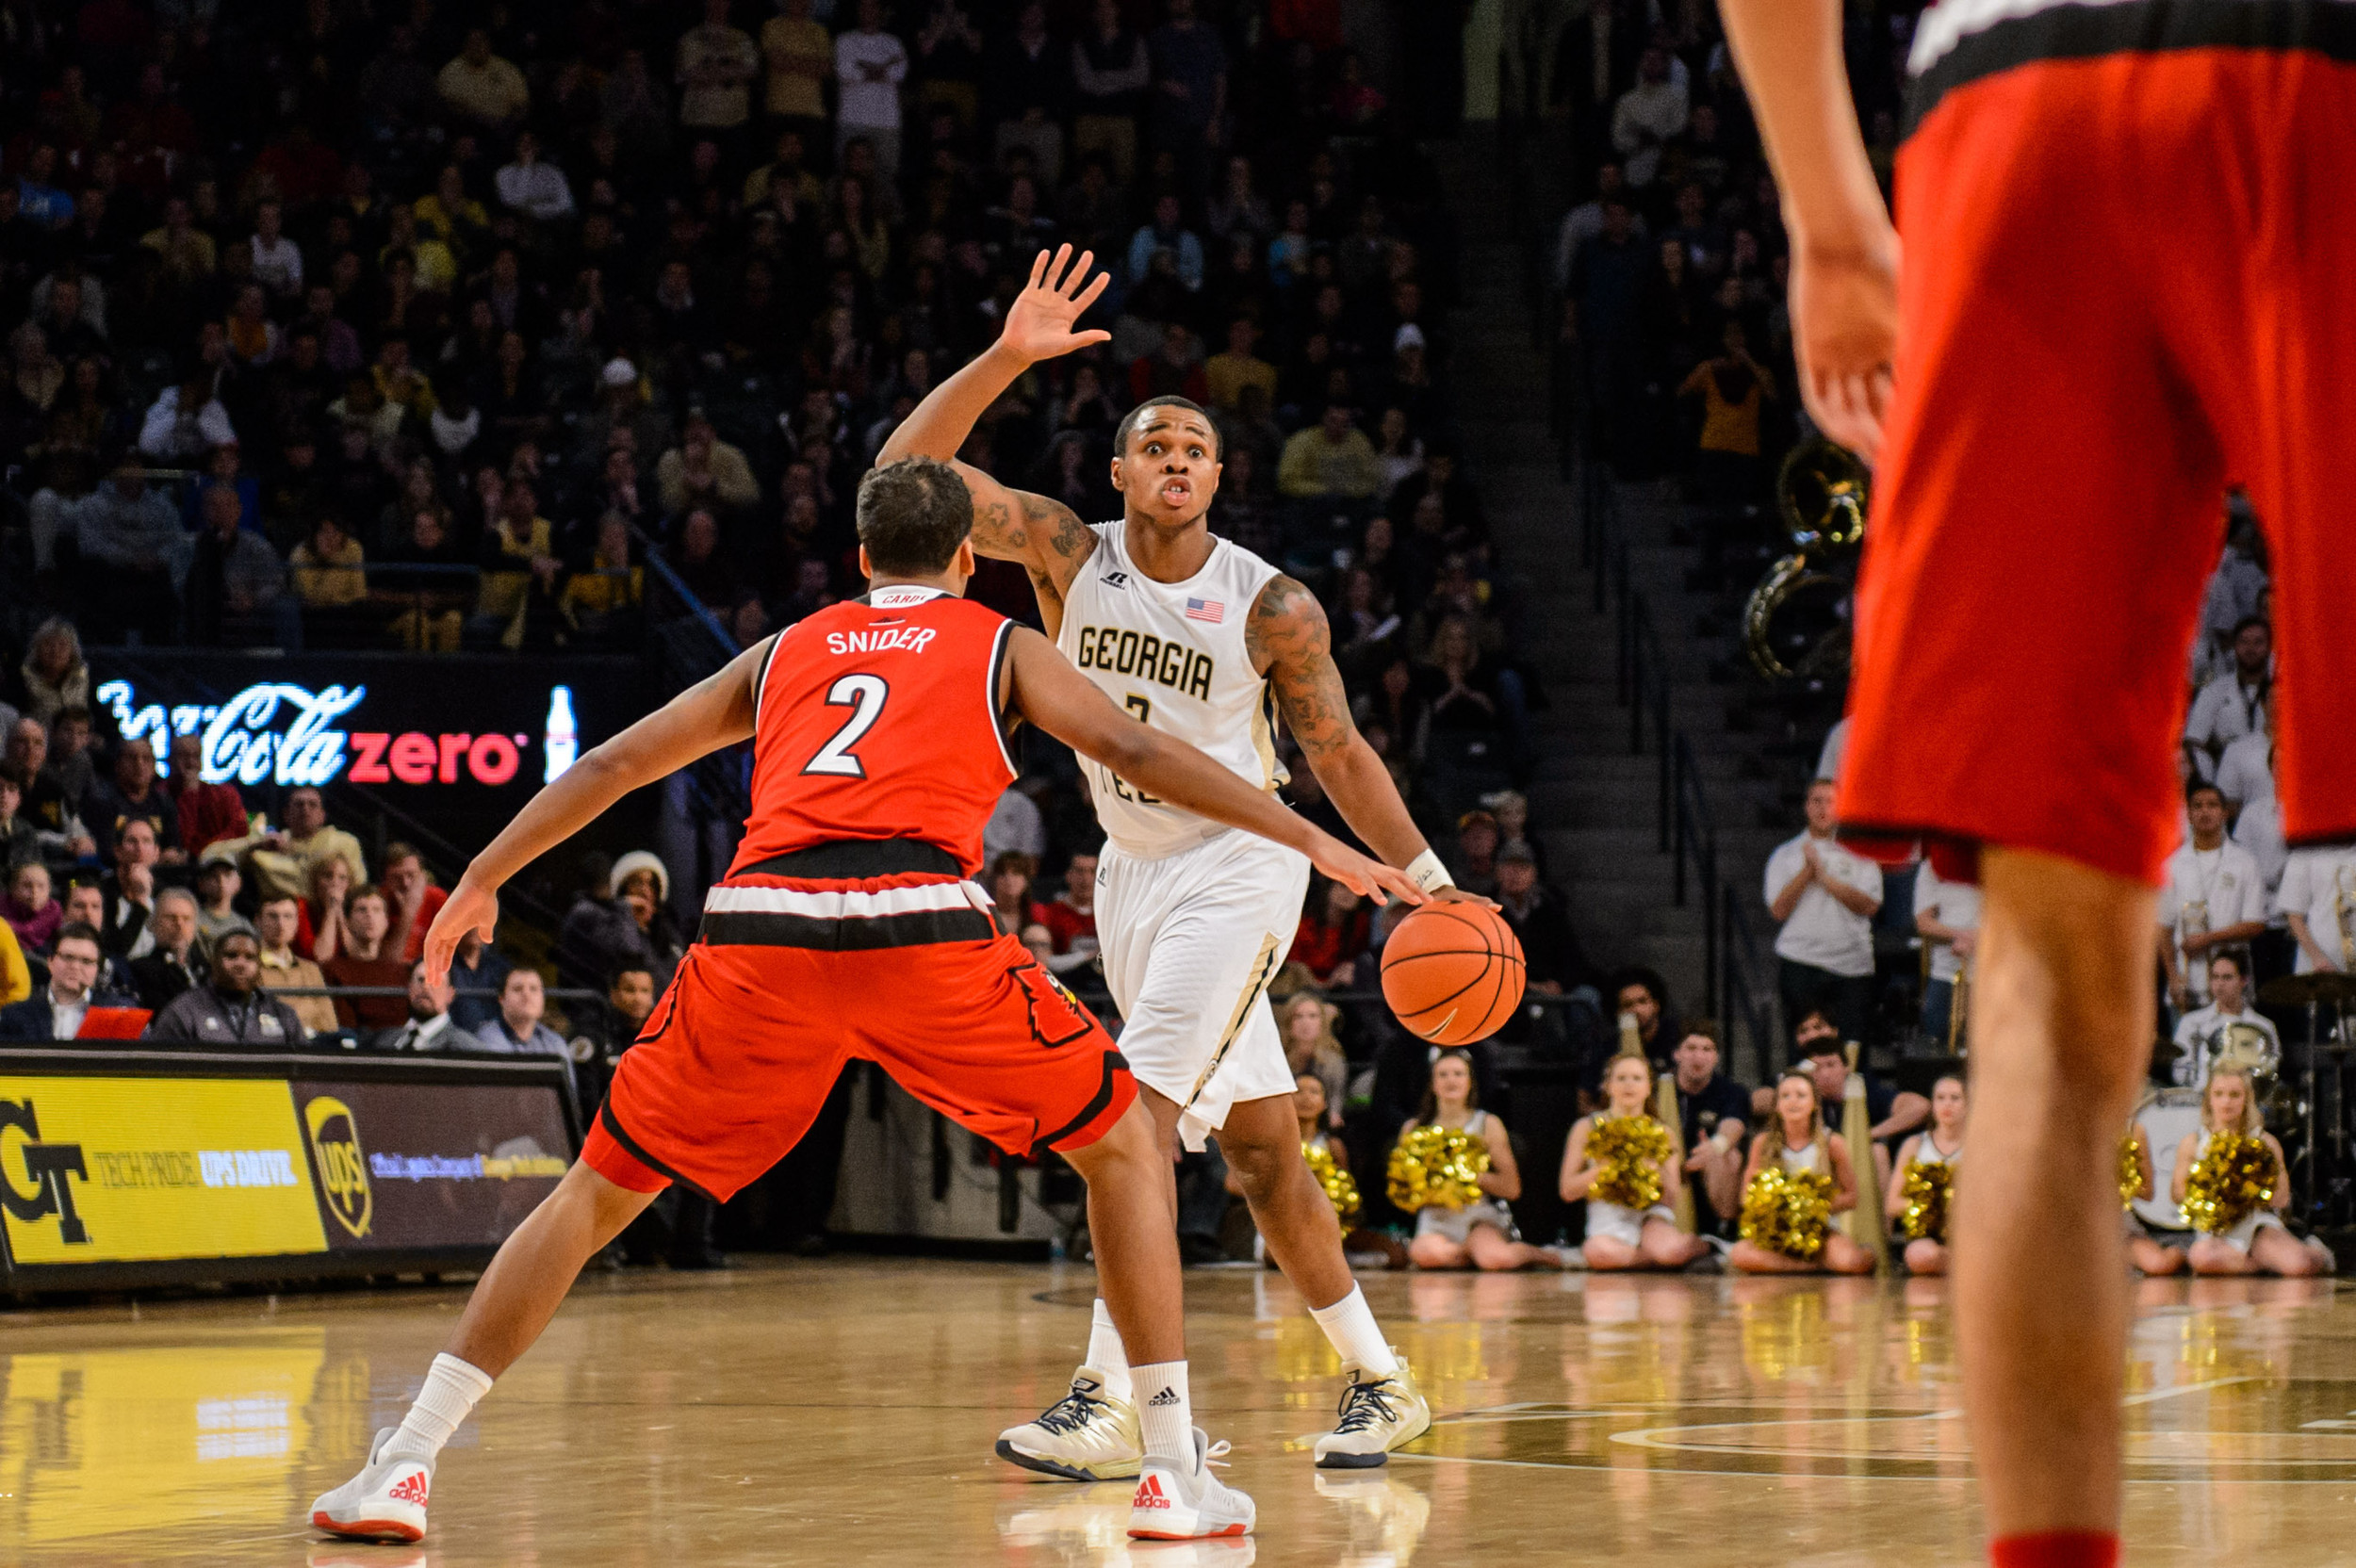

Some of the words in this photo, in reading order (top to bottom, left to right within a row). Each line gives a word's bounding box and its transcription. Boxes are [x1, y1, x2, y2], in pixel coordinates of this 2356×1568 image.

[826, 627, 937, 655] SNIDER
[1078, 626, 1213, 701] GEORGIA
[798, 672, 890, 779] 2
[348, 731, 519, 786] zero
[317, 1141, 366, 1214] ups
[389, 1487, 428, 1508] adida
[1133, 1494, 1170, 1509] didas
